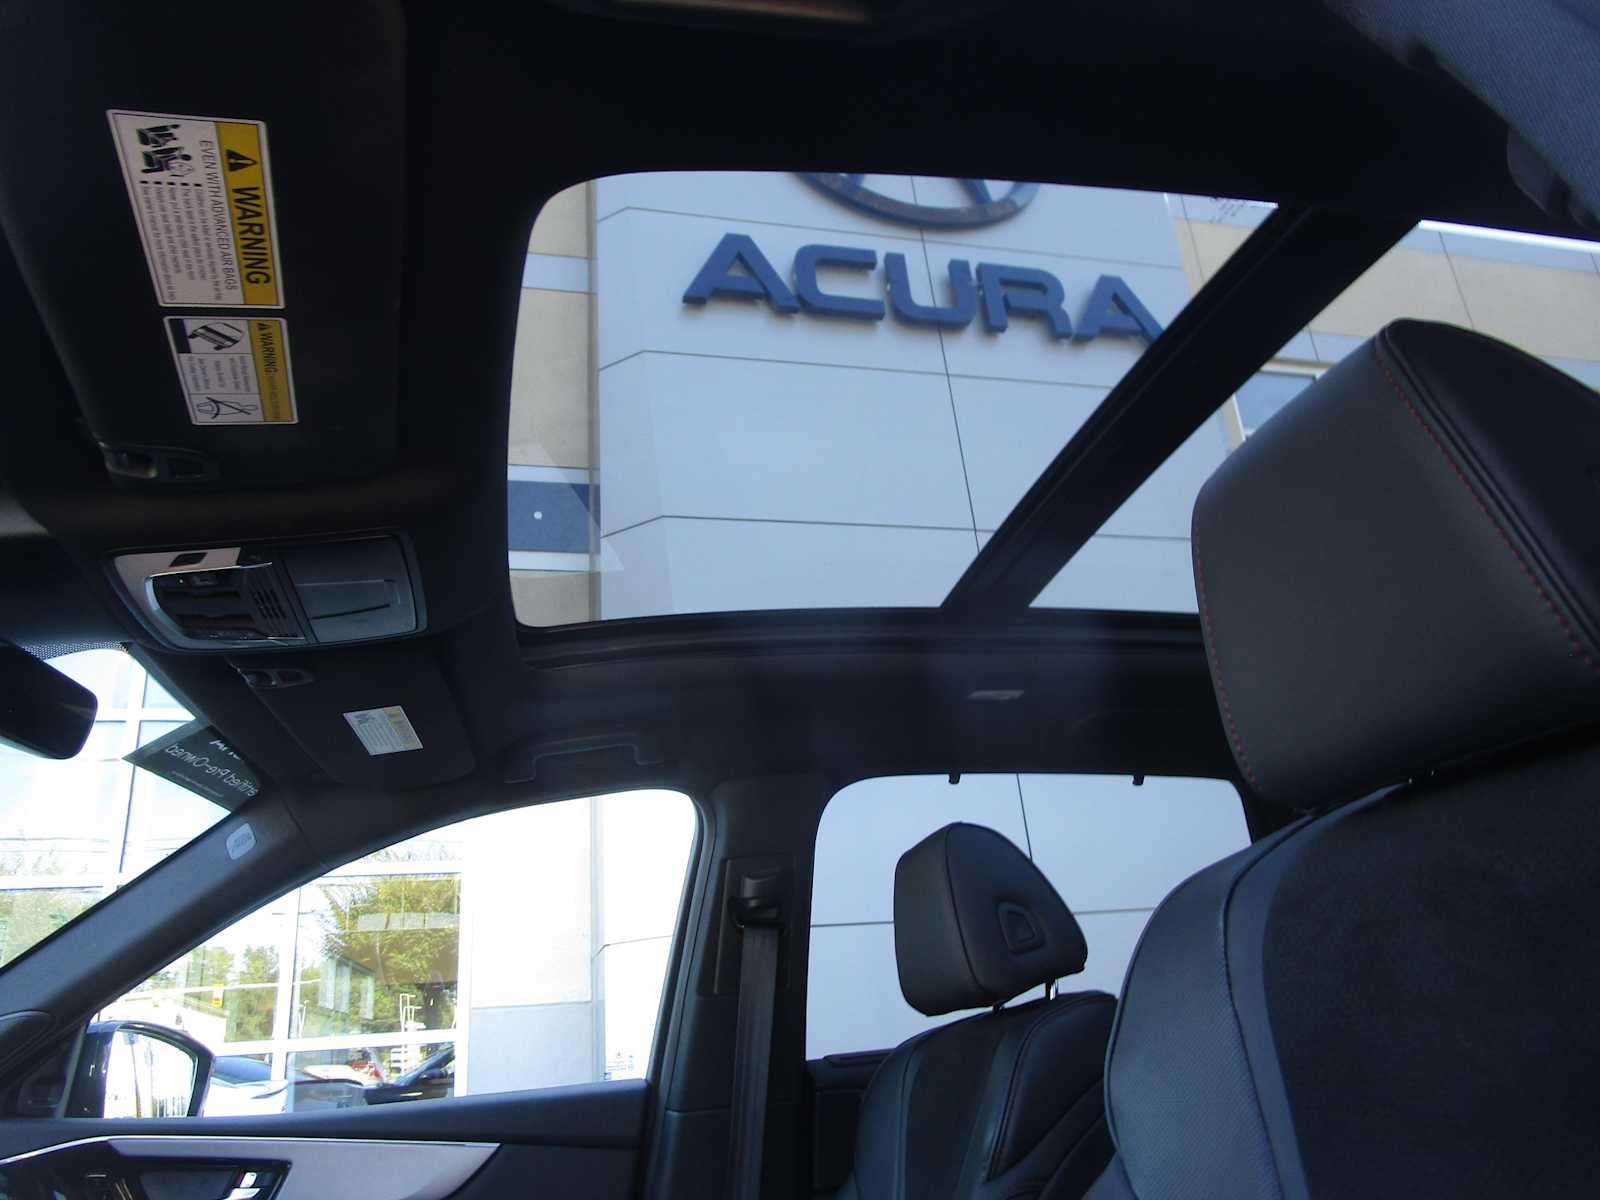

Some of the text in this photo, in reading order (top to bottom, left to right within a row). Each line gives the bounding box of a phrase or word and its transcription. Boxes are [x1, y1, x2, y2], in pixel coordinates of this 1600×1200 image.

[198, 140, 217, 169] EVEN
[204, 172, 222, 197] WITH
[209, 198, 231, 250] ADVANCED
[232, 186, 271, 285] WARNING
[219, 251, 234, 265] AIR
[222, 268, 238, 290] BAGS
[682, 232, 1166, 345] ACURA
